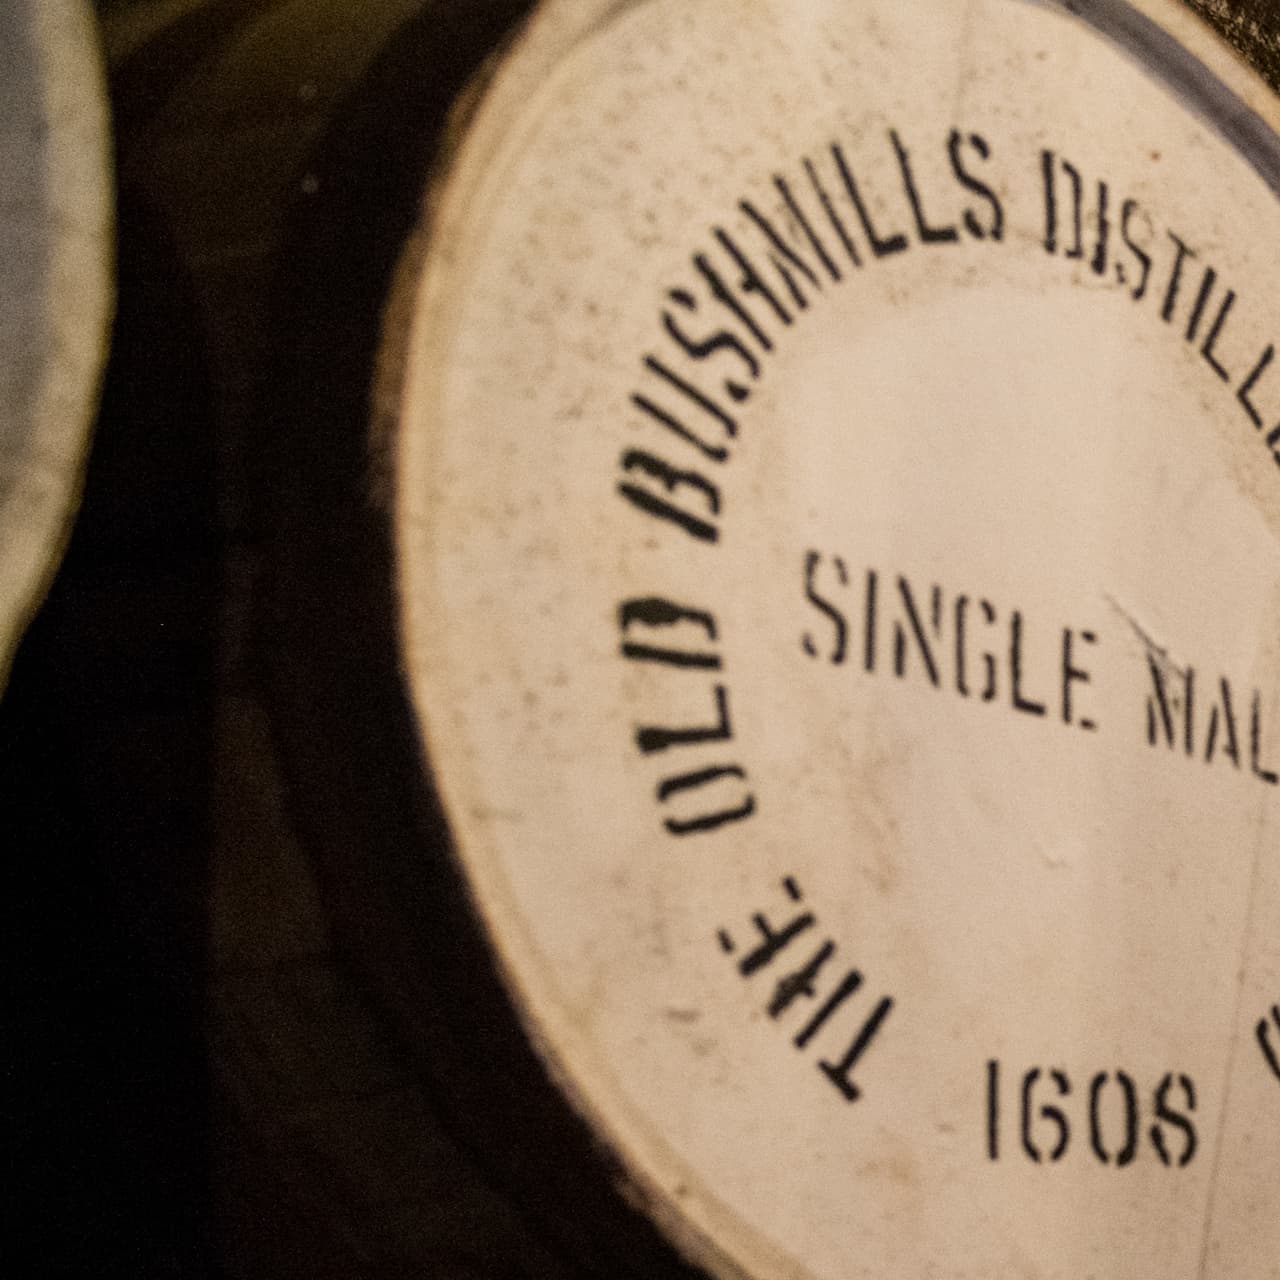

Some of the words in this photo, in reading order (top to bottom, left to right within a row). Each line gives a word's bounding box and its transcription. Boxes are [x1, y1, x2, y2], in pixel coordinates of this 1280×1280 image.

[616, 127, 1004, 544] BUSHMILLS
[619, 598, 756, 837] OLD
[800, 551, 1099, 730] SINGLE
[718, 877, 895, 1103] THE
